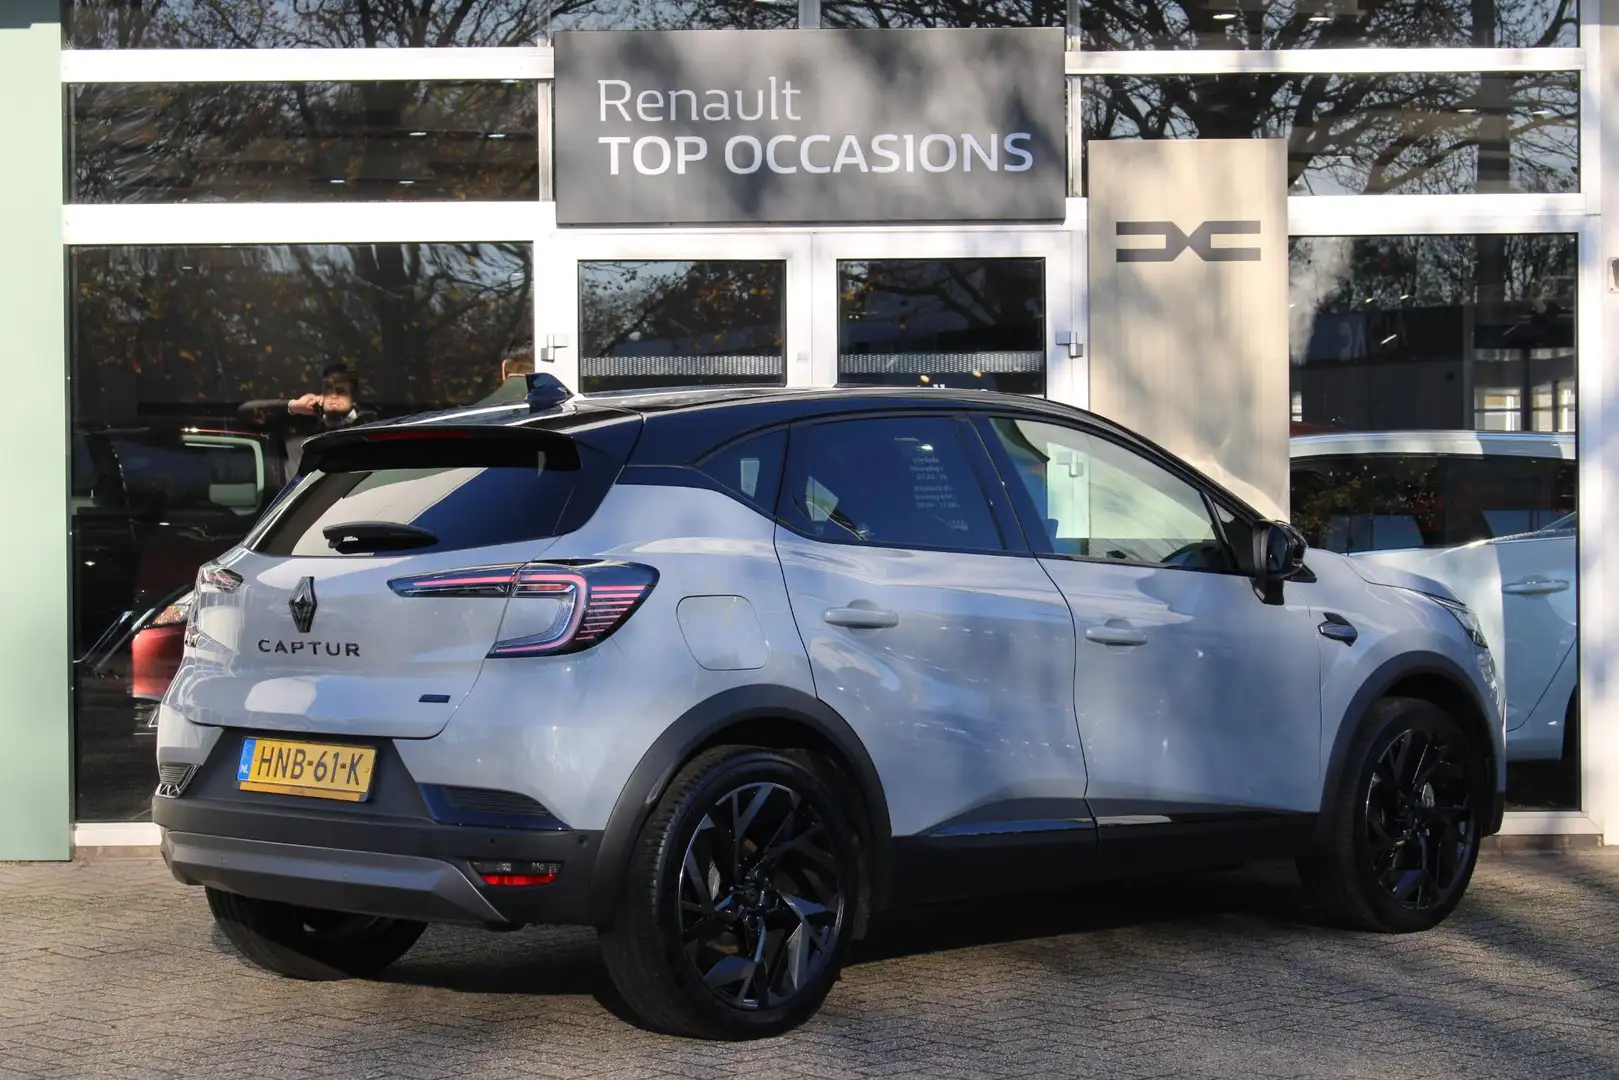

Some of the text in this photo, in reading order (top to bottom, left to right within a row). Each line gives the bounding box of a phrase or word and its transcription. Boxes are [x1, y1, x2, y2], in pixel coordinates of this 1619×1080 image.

[597, 76, 802, 122] Renault
[598, 132, 1035, 175] TOP OCCASIONS
[257, 638, 362, 657] CAPTUR
[239, 746, 364, 786] NL HNB-61-K
